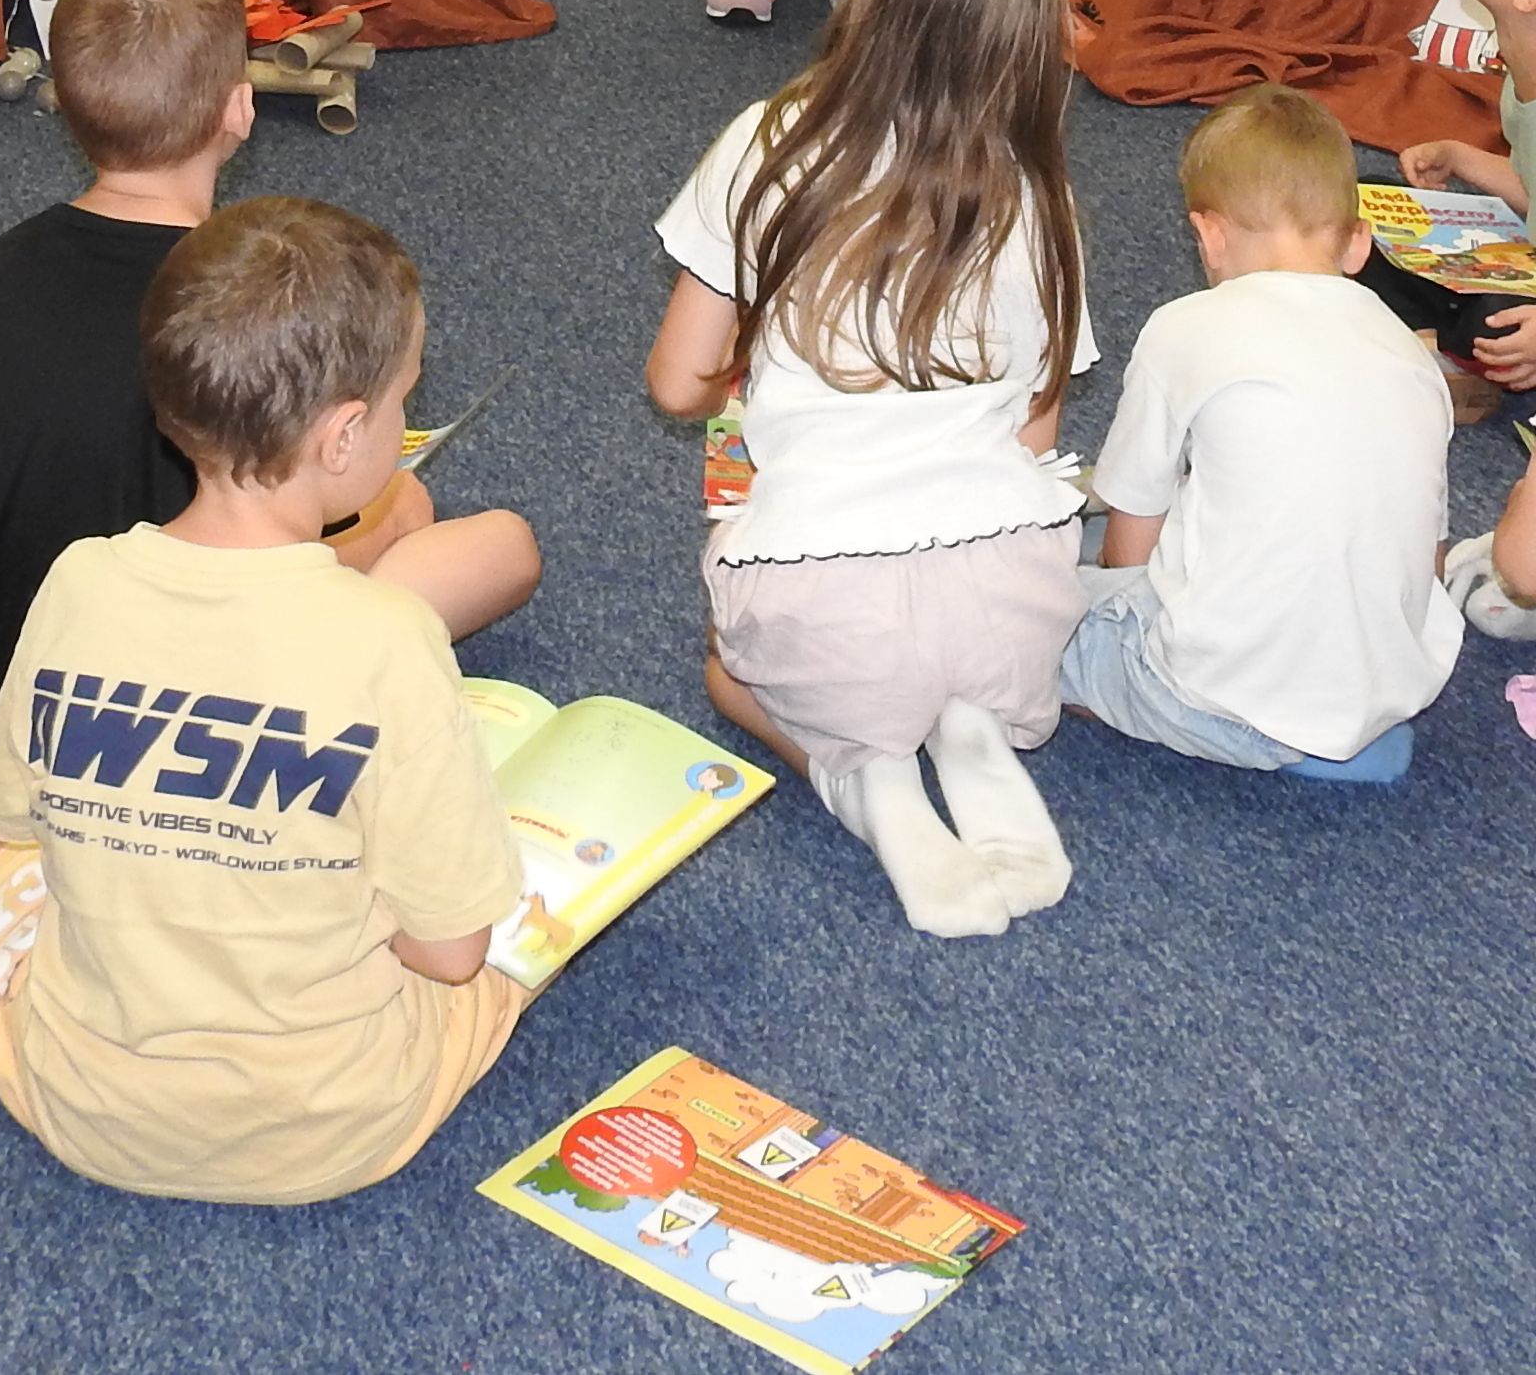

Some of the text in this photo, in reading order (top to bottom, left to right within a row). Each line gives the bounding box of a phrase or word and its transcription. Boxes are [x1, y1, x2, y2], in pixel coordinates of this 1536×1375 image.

[39, 789, 133, 824] POSITIVE
[139, 809, 212, 834] VIBES
[217, 820, 279, 846] ONLY
[102, 835, 158, 857] TOKYO
[176, 846, 290, 872] WORLDWIDE
